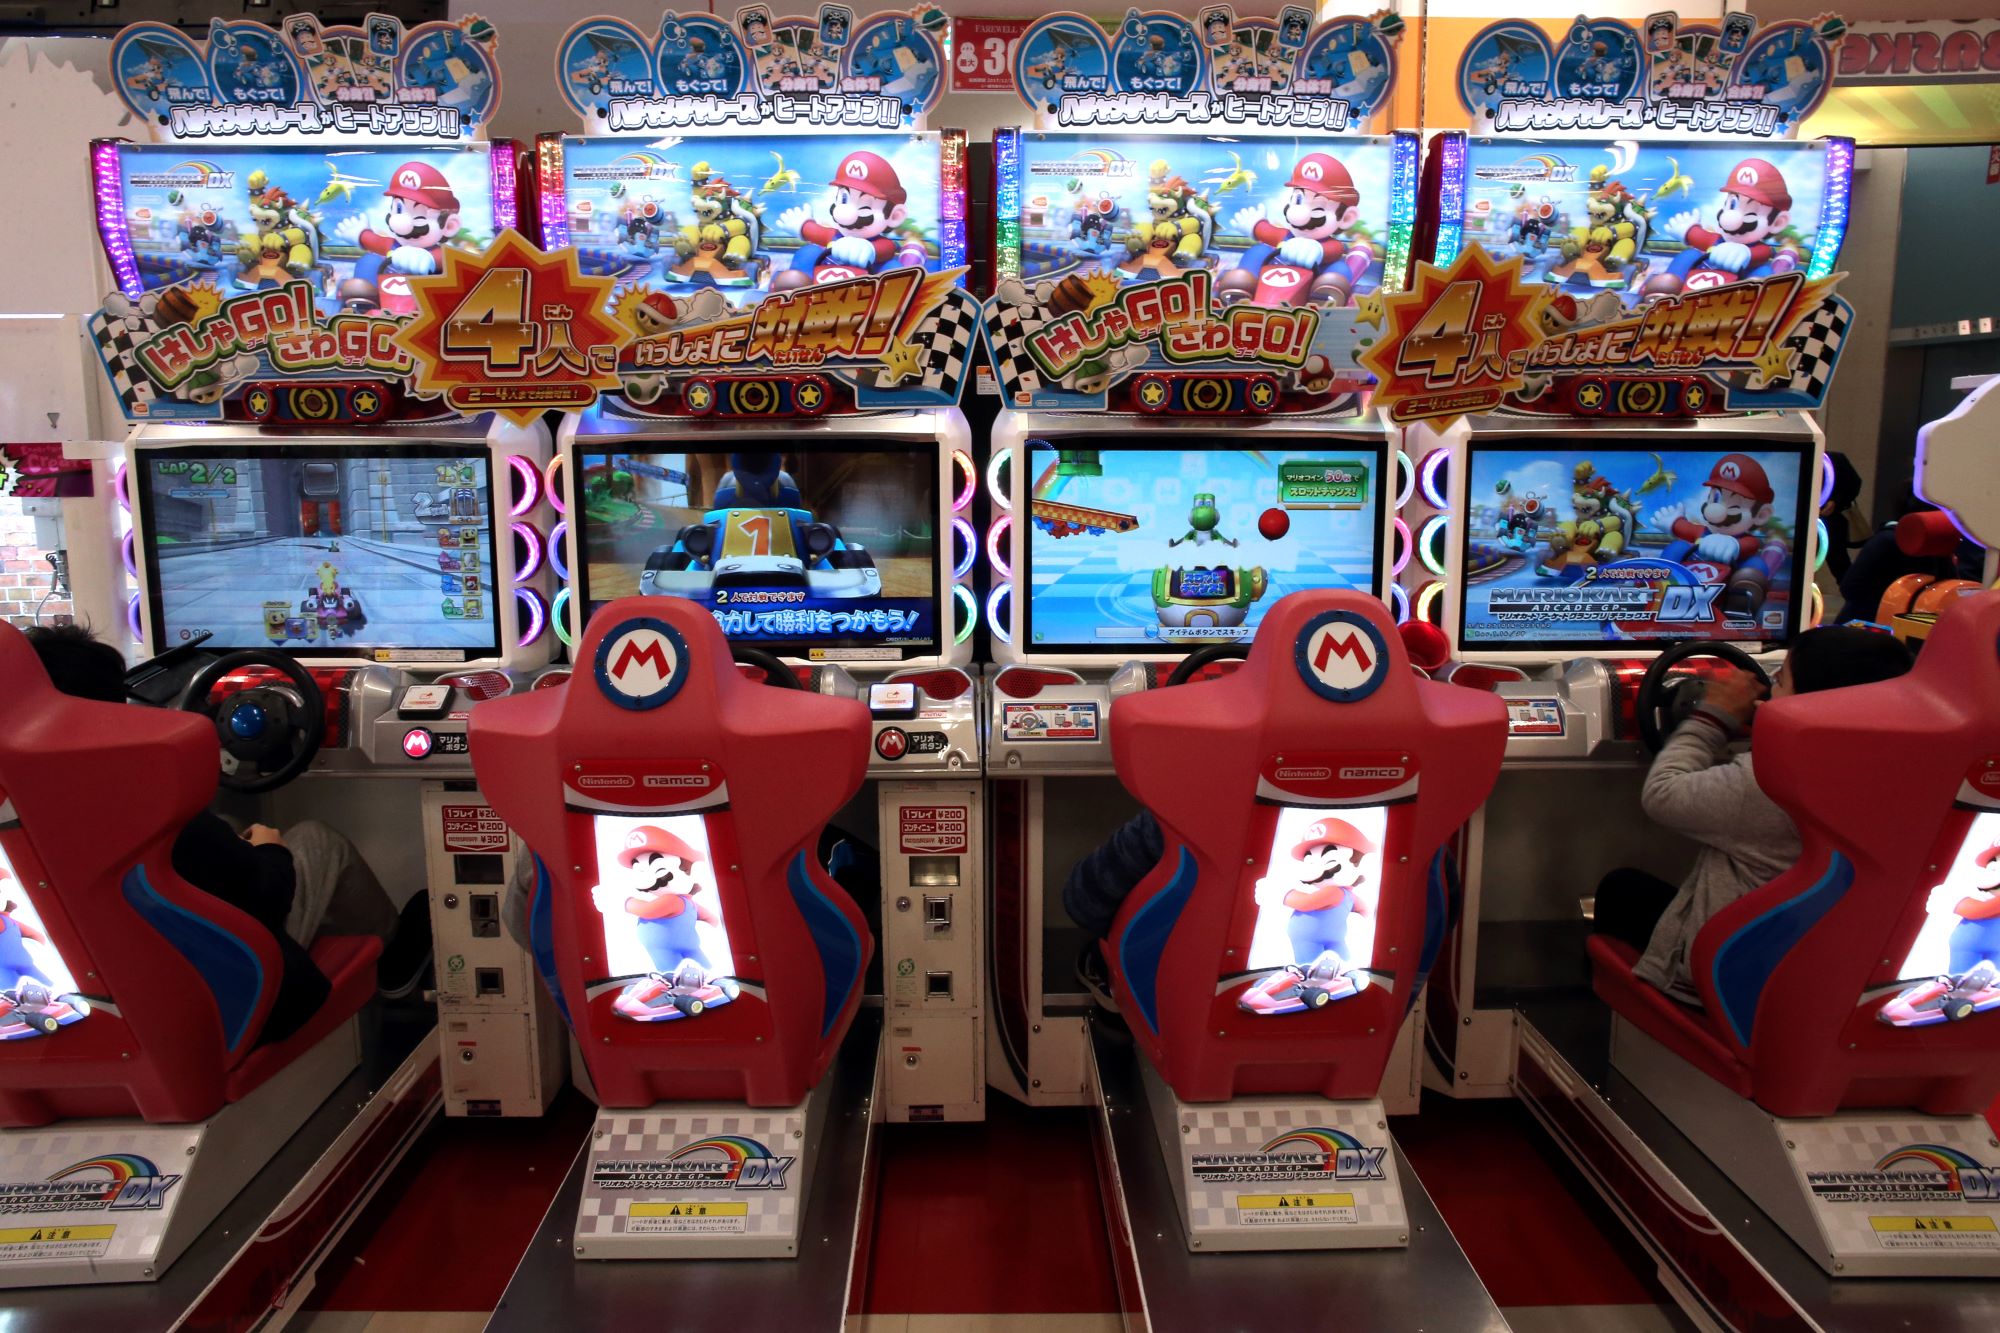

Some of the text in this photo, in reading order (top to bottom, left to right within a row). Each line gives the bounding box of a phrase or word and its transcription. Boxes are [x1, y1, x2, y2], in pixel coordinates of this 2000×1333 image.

[975, 24, 1018, 33] FAREWELL
[676, 79, 727, 93] もぐって!
[1130, 77, 1181, 91] もぐって!
[1035, 273, 1206, 371] はしゃGO!
[144, 285, 309, 381] はしゃGO!
[1169, 312, 1317, 358] さわGO!
[158, 462, 189, 474] LAP
[739, 516, 772, 556] 1
[1656, 583, 1727, 622] DX
[1724, 621, 1755, 629] Nintendo
[1313, 631, 1373, 673] M
[611, 639, 672, 680] M
[406, 734, 428, 751] M
[445, 743, 468, 751] ボタン
[1278, 769, 1400, 777] Nintendo namco
[647, 777, 705, 785] namco
[905, 810, 962, 819] 1プレイ ¥200
[447, 823, 503, 831] コンティニュー ¥200
[904, 823, 962, 832] コンティニュー ¥200
[938, 836, 962, 845] ¥300
[1335, 1147, 1387, 1179] DX
[735, 1157, 795, 1189] DX
[109, 1175, 182, 1209] DX
